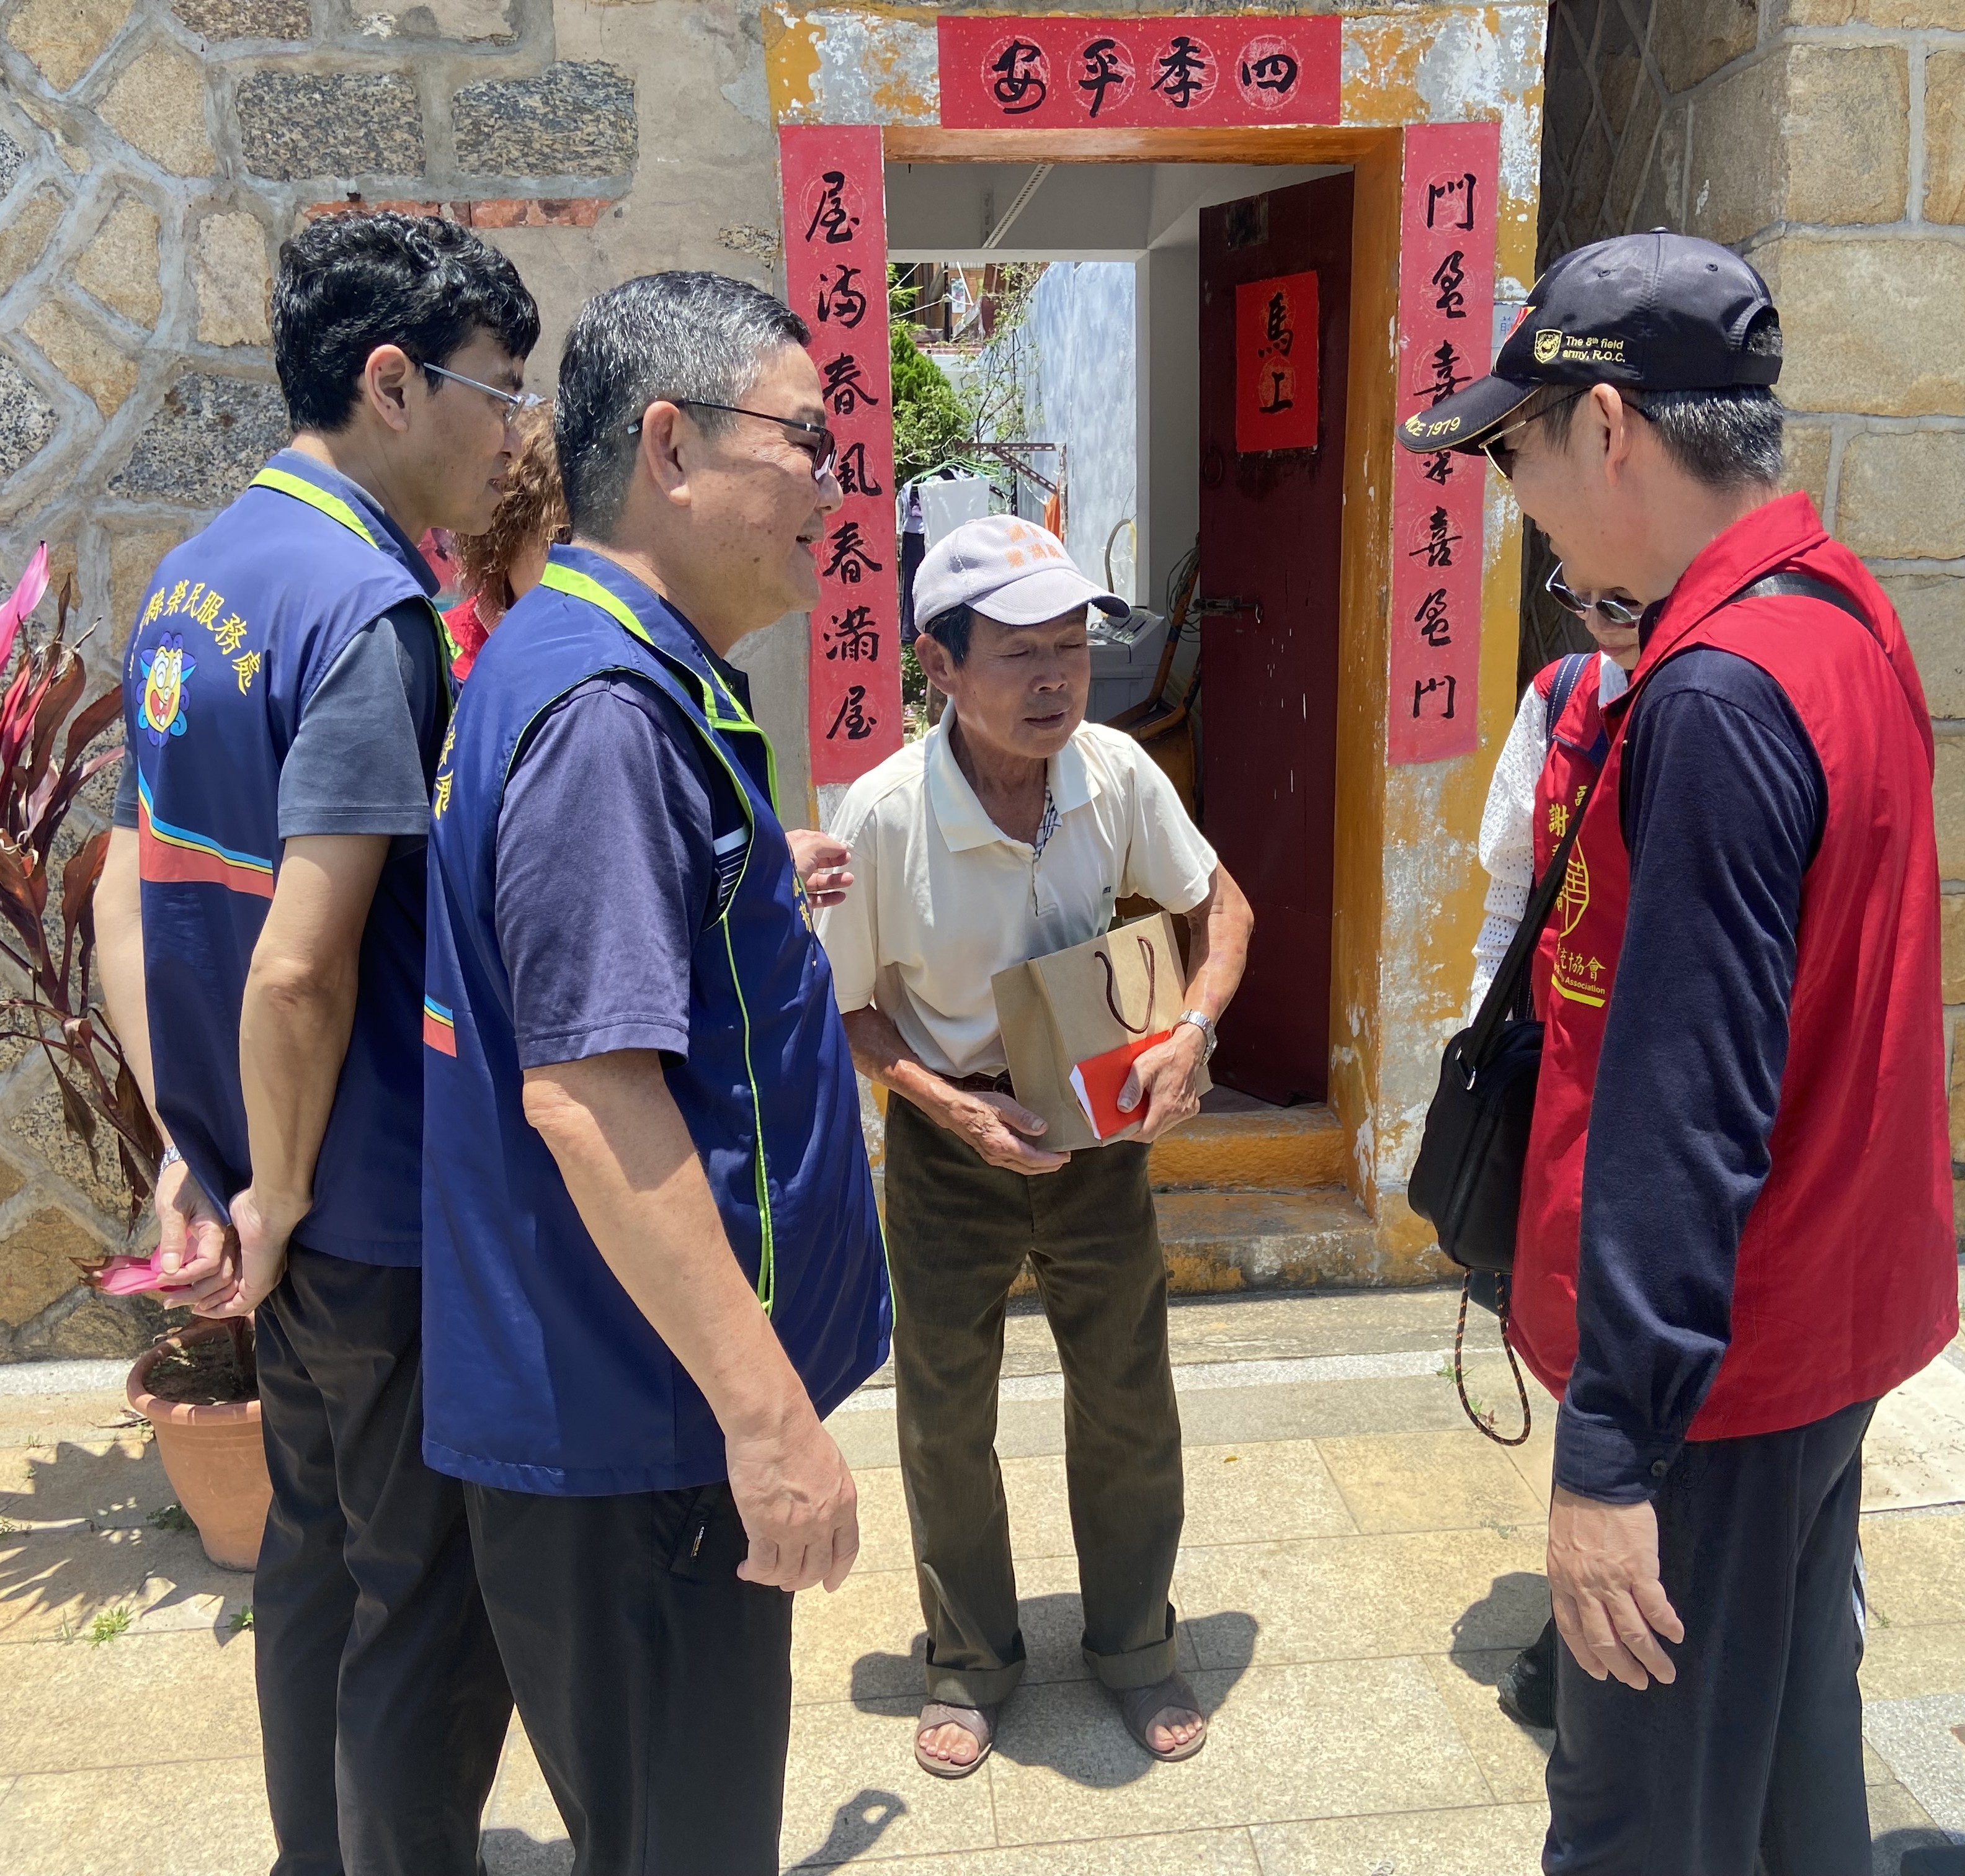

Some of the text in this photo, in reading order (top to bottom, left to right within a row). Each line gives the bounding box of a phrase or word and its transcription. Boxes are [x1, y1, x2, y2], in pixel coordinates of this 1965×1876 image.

[1257, 292, 1294, 414] 馬上
[1566, 336, 1624, 350] The 8th field
[1562, 349, 1626, 363] army, R.O.C.
[1426, 416, 1461, 437] 1979
[128, 579, 261, 696] 縣榮民服務處
[1564, 976, 1606, 995] Association
